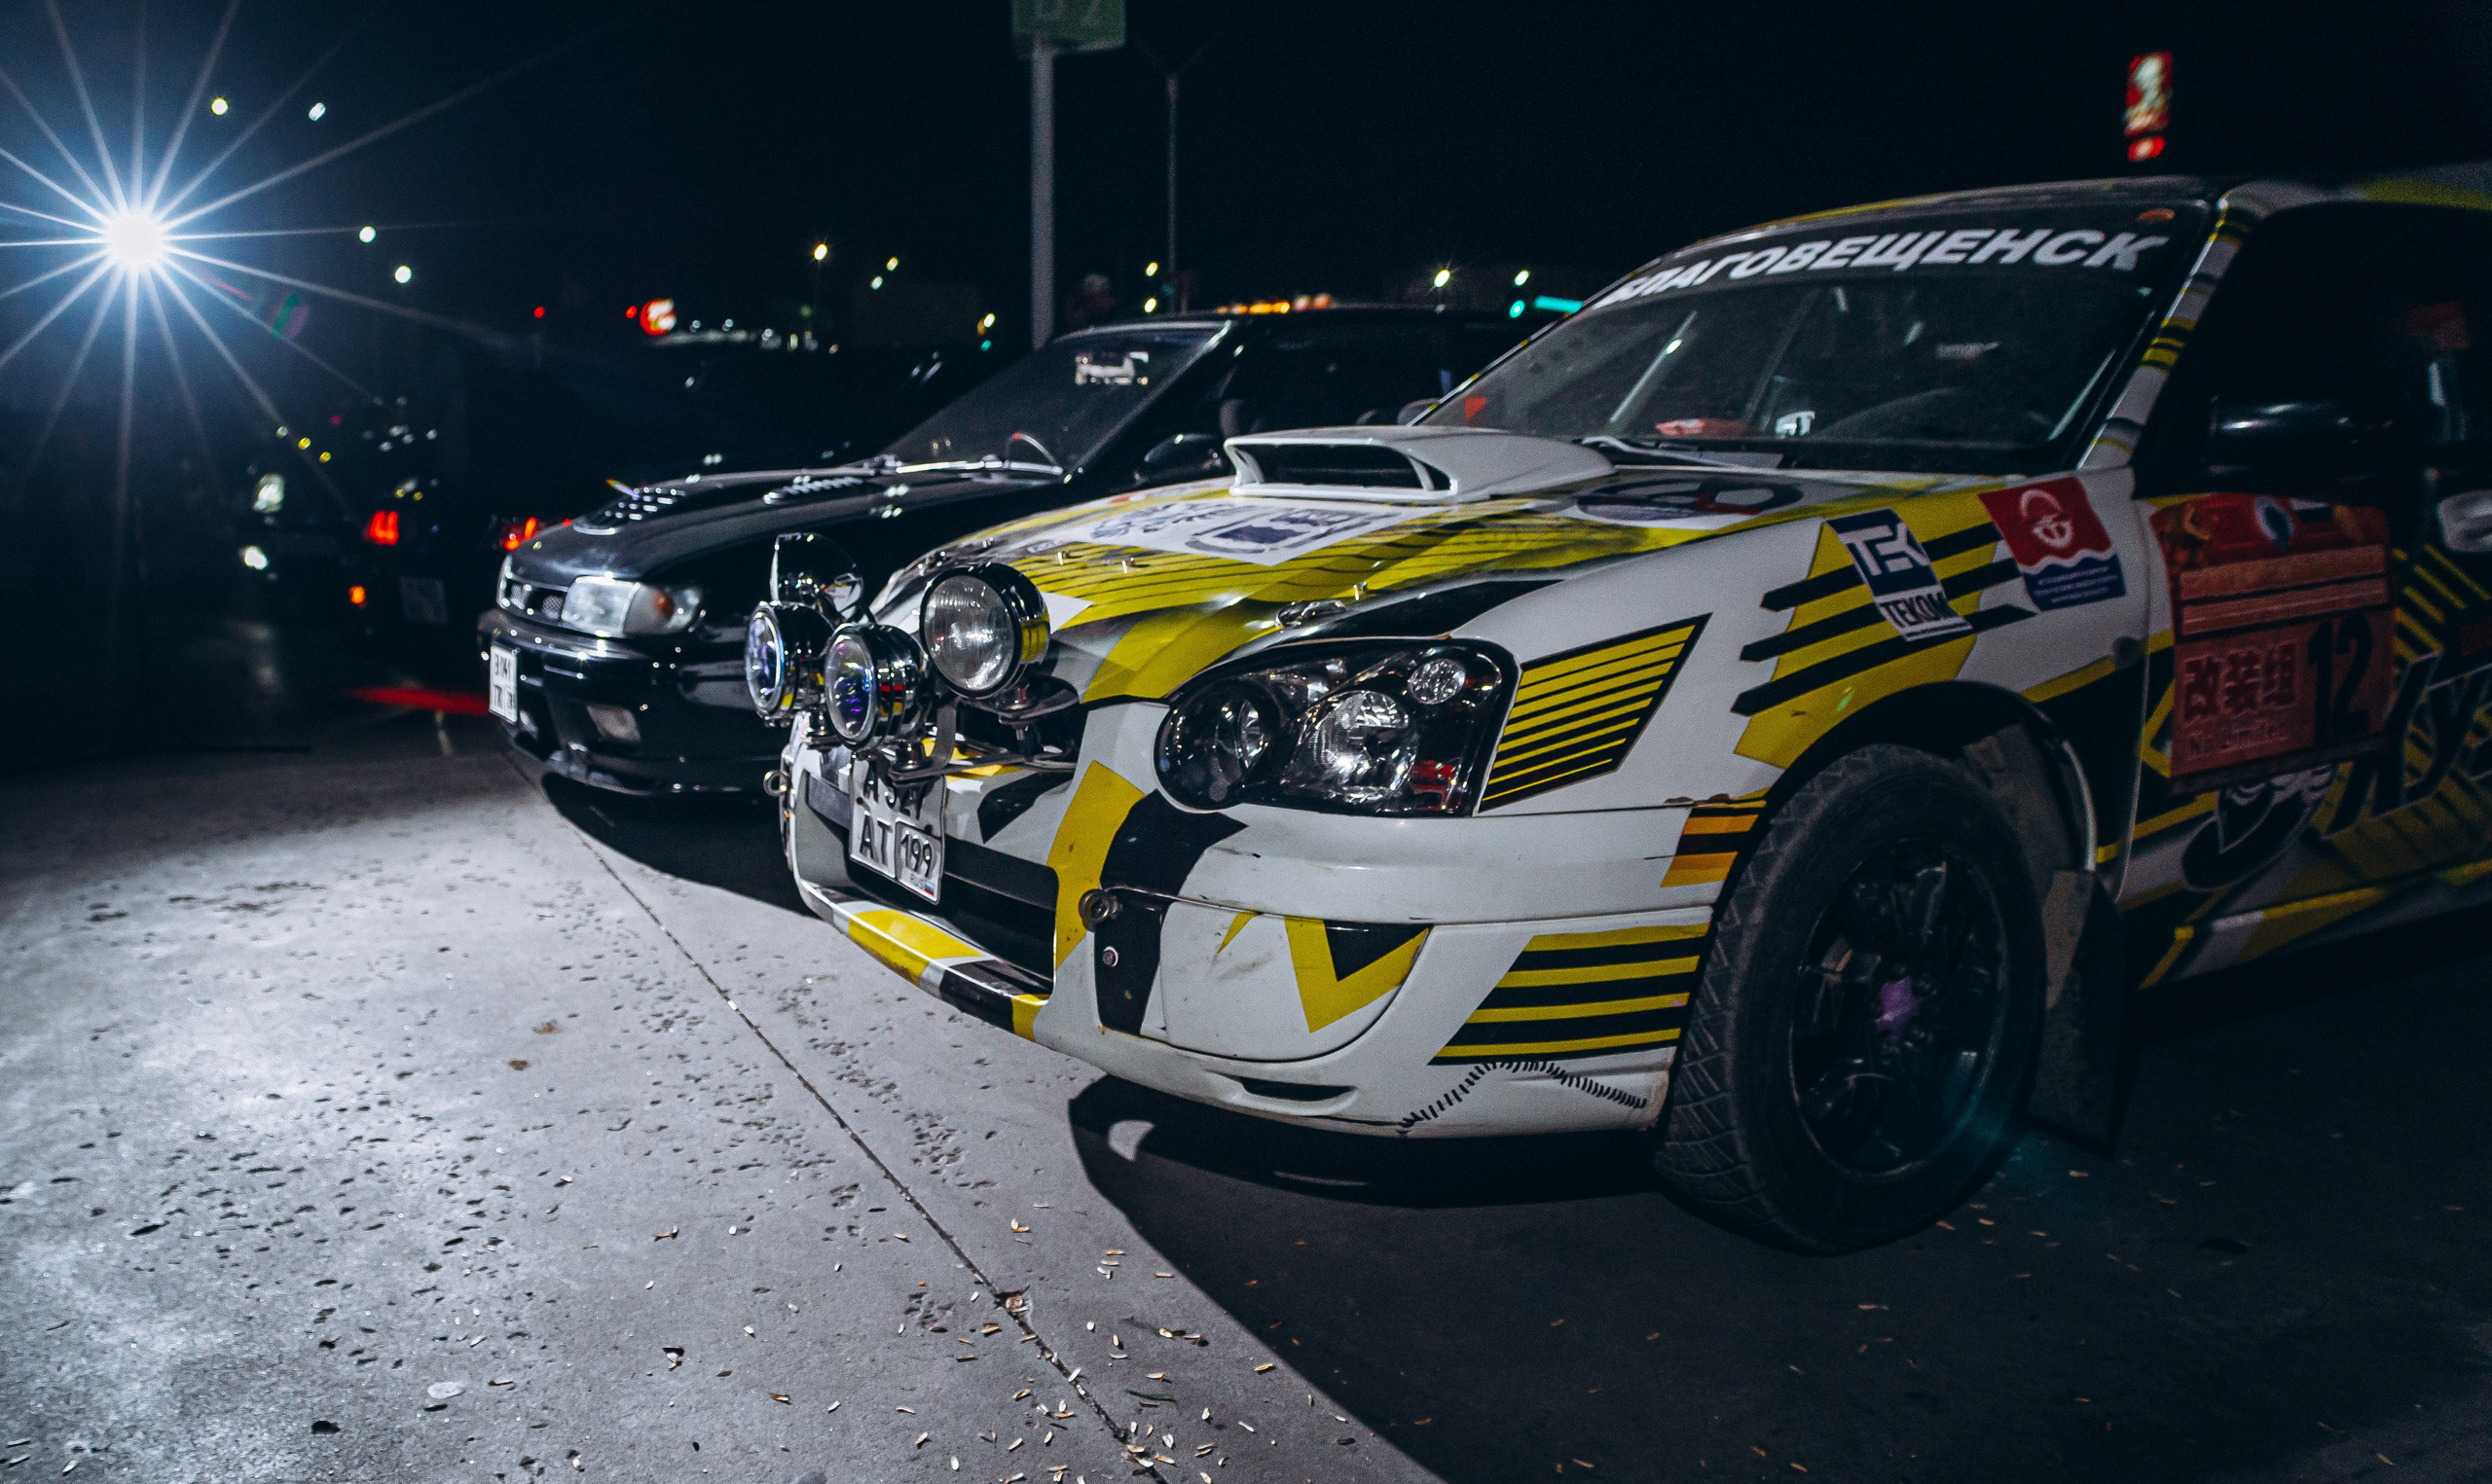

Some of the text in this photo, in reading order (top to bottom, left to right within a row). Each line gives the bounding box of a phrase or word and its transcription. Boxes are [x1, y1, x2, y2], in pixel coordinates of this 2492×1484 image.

[2307, 613, 2373, 745] 12
[860, 813, 893, 866] AT
[900, 830, 934, 877] 199
